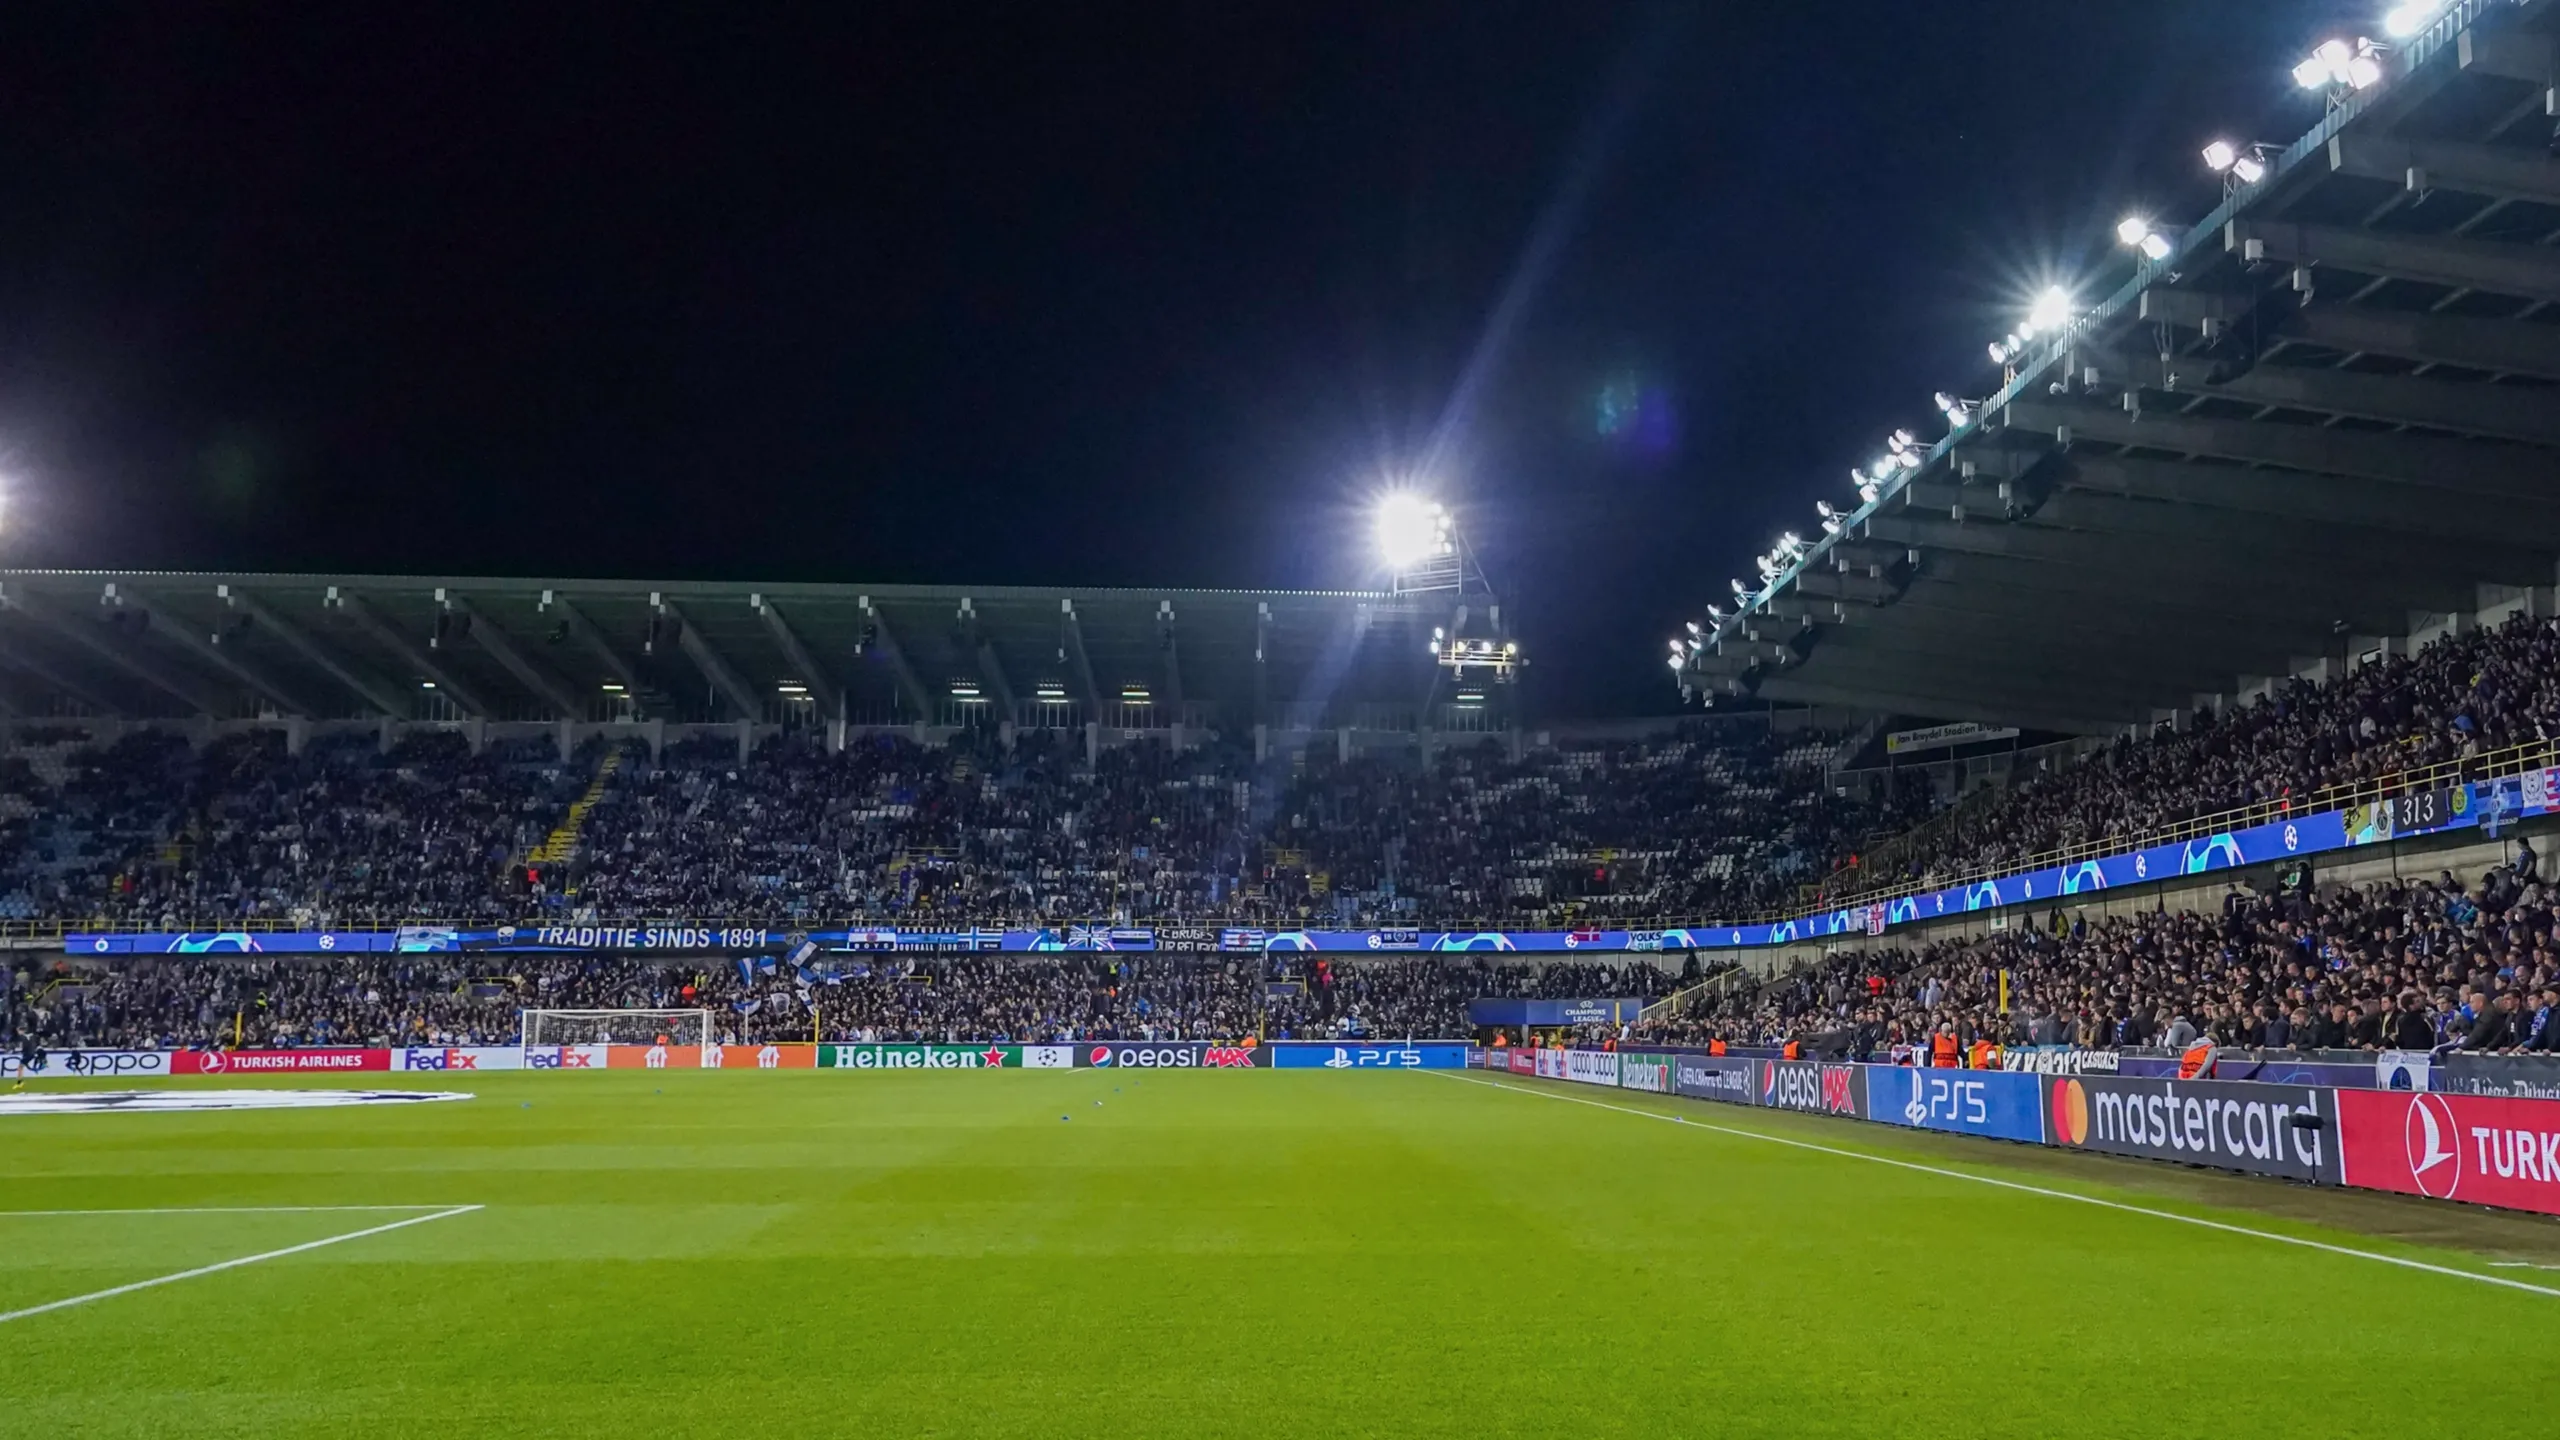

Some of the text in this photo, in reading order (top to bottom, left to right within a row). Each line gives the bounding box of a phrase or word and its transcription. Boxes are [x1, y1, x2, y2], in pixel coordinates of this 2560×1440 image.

[2403, 793, 2434, 826] 313
[537, 927, 767, 948] TRADITIE SINDS 1891
[1630, 932, 1662, 942] VOLKS
[232, 1055, 362, 1068] TURKISH AIRLINES
[405, 1048, 478, 1070] FedEx
[525, 1047, 591, 1068] FedEx
[834, 1046, 977, 1068] Heineken
[1119, 1046, 1257, 1068] pepsi MAX
[1359, 1050, 1421, 1066] PS5
[1622, 1054, 1660, 1092] Heineken
[1723, 1070, 1743, 1091] LEAGUE
[1778, 1062, 1856, 1114] pepsi MAX
[1931, 1079, 1986, 1123] PS5
[2095, 1082, 2323, 1166] mastercard
[2471, 1127, 2560, 1182] TURK
